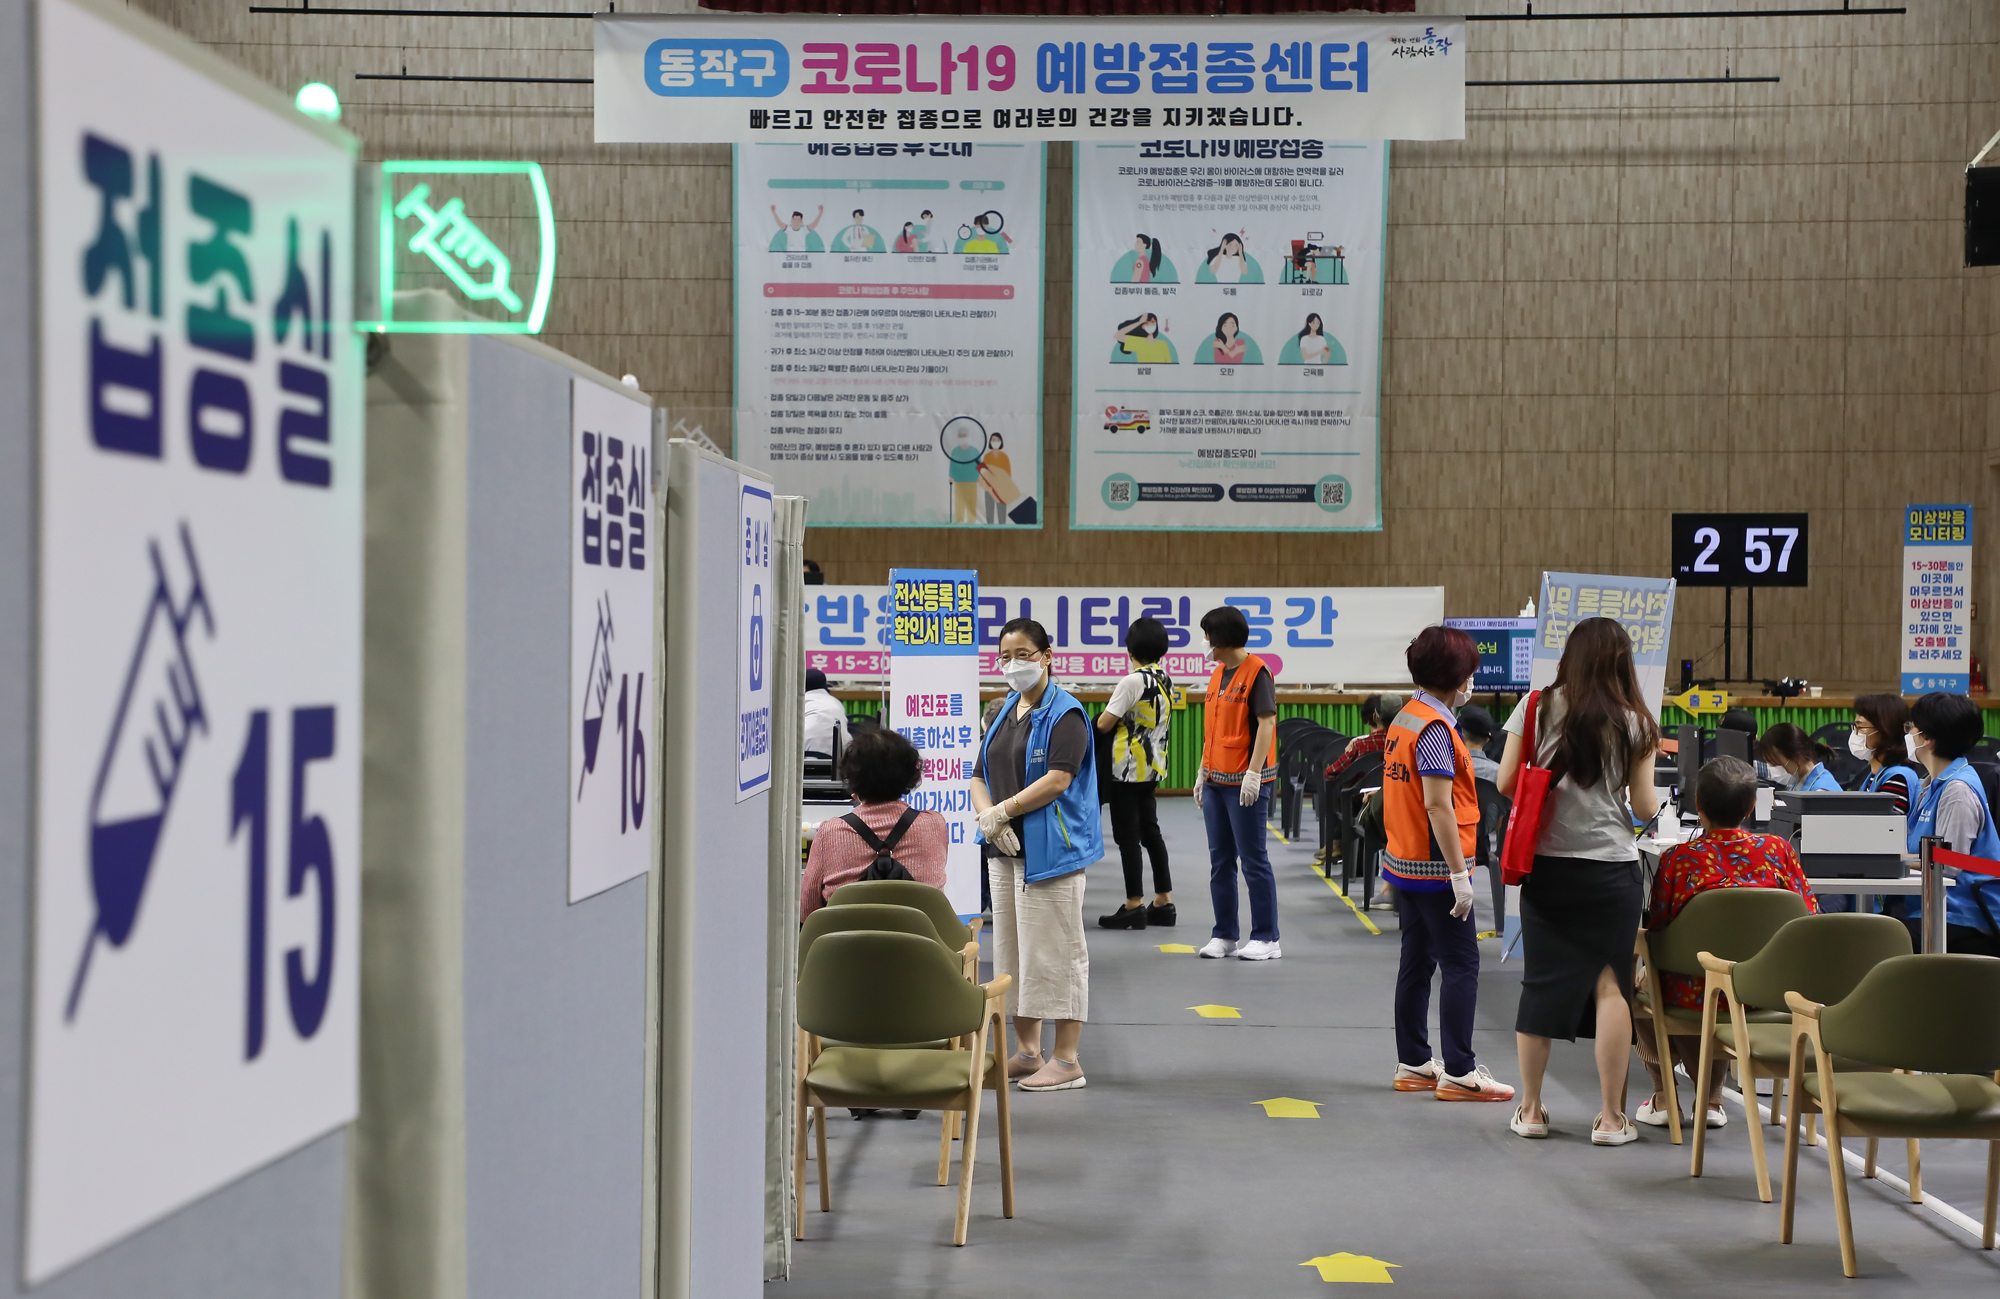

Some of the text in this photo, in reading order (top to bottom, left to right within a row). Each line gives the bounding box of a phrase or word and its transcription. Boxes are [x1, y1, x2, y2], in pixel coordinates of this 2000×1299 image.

[1422, 27, 1452, 56] 동작
[660, 41, 1368, 95] 동작구 코로나19 예방접종센터
[749, 106, 1302, 130] 빠르고 안전한 접종으로 여러분의 건강을 지키겠습니다.
[1118, 166, 1148, 175] 코로나19
[1149, 167, 1188, 176] 예방접종은
[1189, 167, 1205, 176] 우리
[1223, 167, 1262, 176] 바이러스에
[1296, 167, 1327, 176] 면역력을
[1274, 178, 1298, 187] 도움이
[1299, 178, 1324, 187] 됩니다.
[1222, 287, 1237, 296] 두통
[1301, 288, 1323, 296] 피로감
[81, 129, 334, 490] 접종실
[1219, 367, 1234, 376] 오한
[1197, 449, 1257, 458] 예방접종도우미
[582, 430, 647, 571] 접종실
[1910, 510, 1966, 526] 이상반응
[1909, 526, 1966, 541] 모니터링
[1693, 526, 1721, 573] 2
[1744, 527, 1799, 574] 57
[1921, 573, 1954, 584] 이곳에
[894, 582, 974, 612] 전산등록 및
[1910, 586, 1964, 596] 머무르면서
[1910, 598, 1963, 609] 이상반응이
[1224, 596, 1339, 648] 공간
[1920, 611, 1953, 622] 있으면
[894, 615, 940, 645] 확인서
[943, 615, 974, 645] 발급
[1908, 624, 1963, 634] 의자에 있는
[1476, 641, 1498, 654] 순님
[1914, 636, 1957, 647] 호출벨을
[1908, 649, 1963, 660] 눌러주세요
[811, 653, 829, 672] 후
[834, 655, 890, 672] 15~30
[1050, 656, 1086, 674] 반응
[1927, 678, 1957, 689] 동작구
[1172, 691, 1182, 703] 구
[1689, 694, 1723, 707] 출구
[906, 694, 963, 717] 예진표를
[958, 725, 972, 748] 후
[616, 670, 646, 835] 16
[922, 758, 973, 781] 확인서를
[229, 705, 336, 1062] 15
